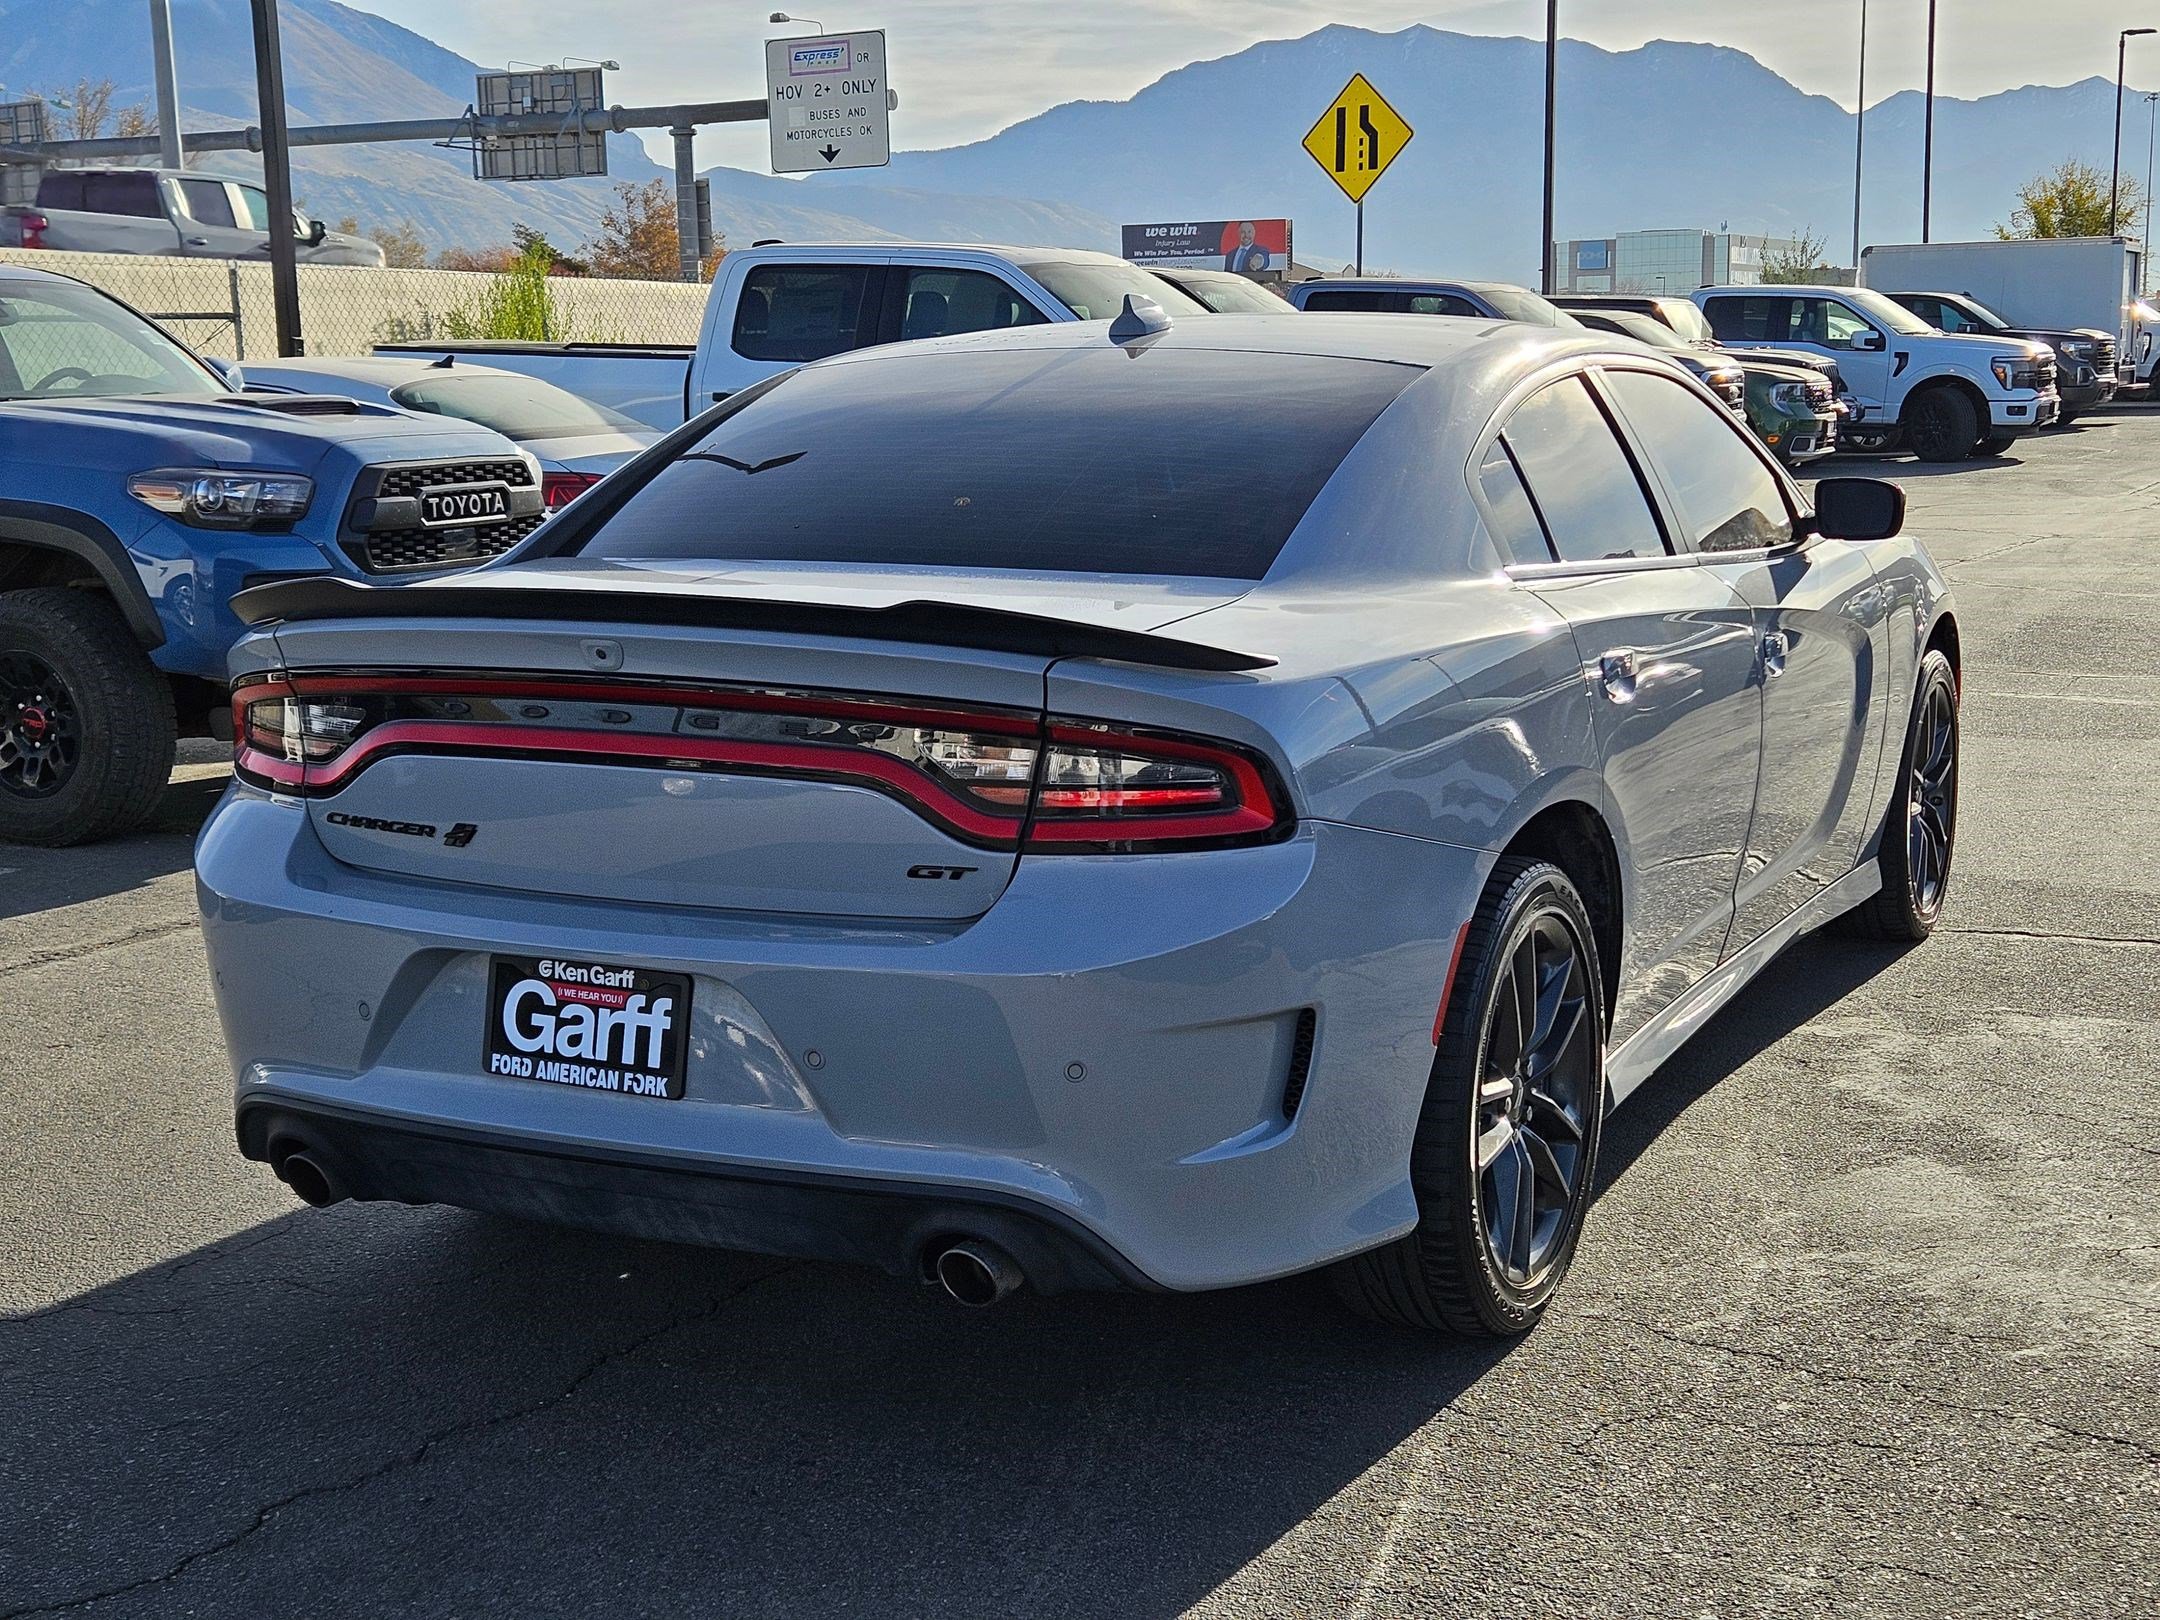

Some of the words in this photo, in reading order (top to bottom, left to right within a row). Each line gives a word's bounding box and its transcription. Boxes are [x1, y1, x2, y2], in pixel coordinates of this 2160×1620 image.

[793, 48, 841, 66] Express
[856, 52, 870, 63] OR
[776, 84, 803, 101] HOV
[814, 83, 831, 97] 2+
[841, 78, 877, 95] ONLY
[809, 109, 841, 121] BUSES
[847, 107, 867, 118] AND
[786, 126, 852, 141] MOTORCYCLES
[859, 125, 873, 136] OK
[1145, 226, 1167, 237] we
[1155, 240, 1175, 248] Injury
[428, 492, 505, 518] TOYOTA
[326, 811, 437, 838] CHARGER
[906, 864, 979, 880] GT
[554, 961, 589, 983] Ken
[589, 965, 635, 989] Garff
[563, 988, 578, 999] WE
[577, 990, 600, 1002] HEAR
[600, 993, 618, 1004] YOU
[503, 978, 673, 1069] Garff
[491, 1053, 532, 1077] FORD
[535, 1060, 619, 1091] AMERICAN
[623, 1073, 669, 1098] FORK
